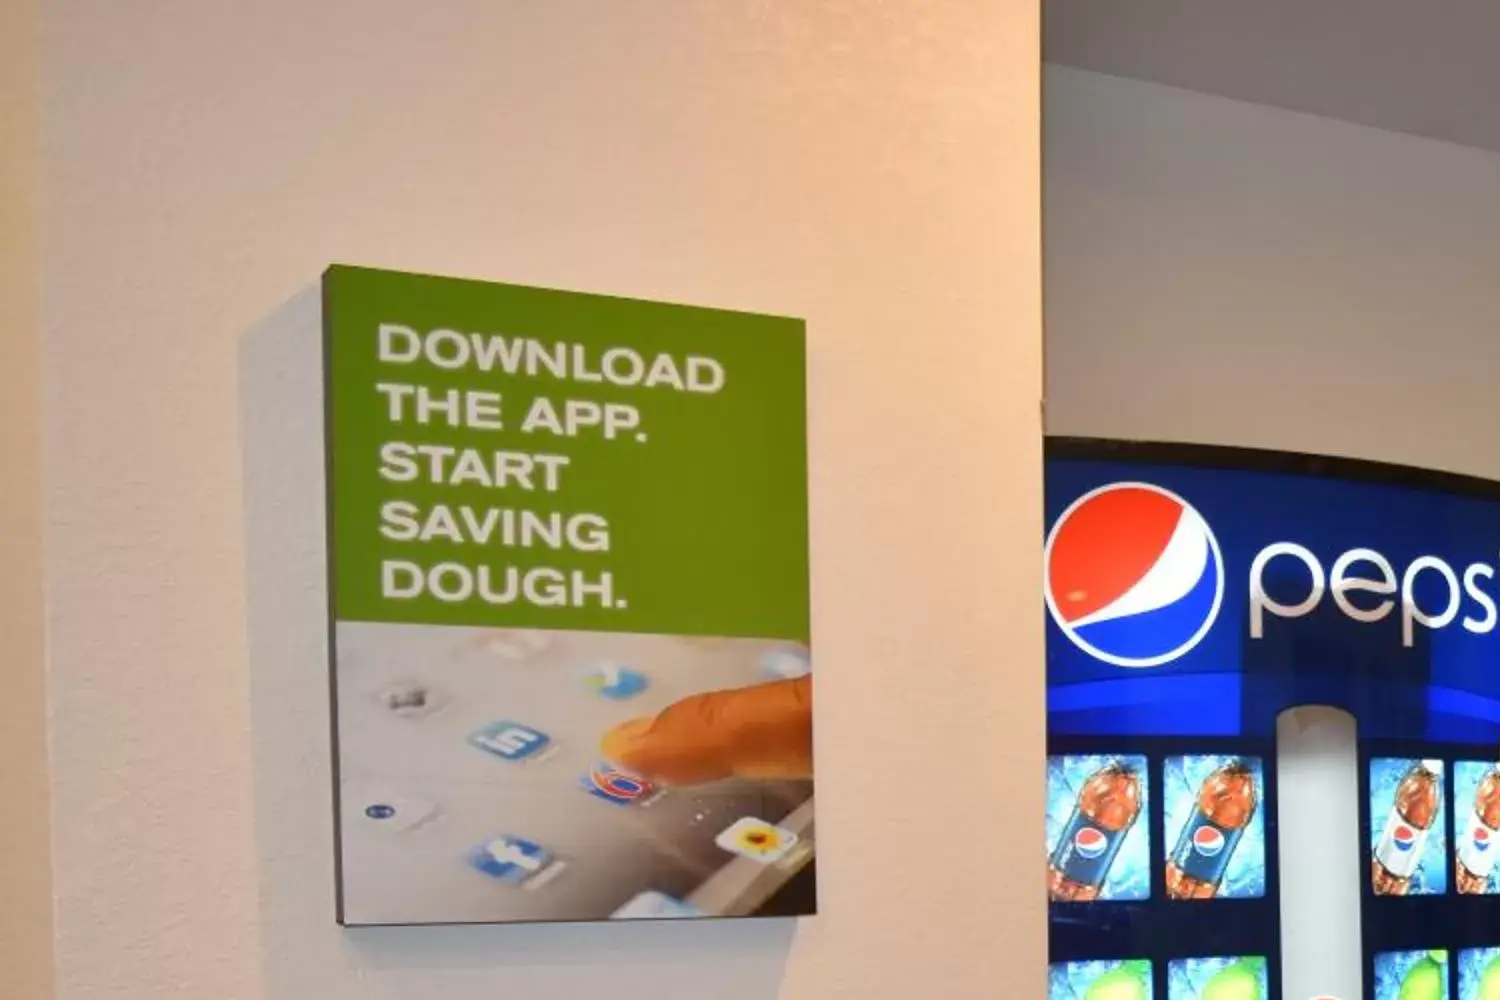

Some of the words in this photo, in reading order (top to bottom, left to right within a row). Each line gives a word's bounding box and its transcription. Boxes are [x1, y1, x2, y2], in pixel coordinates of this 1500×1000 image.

[377, 323, 726, 394] DOWNLOAD
[376, 382, 504, 431] THE
[521, 397, 648, 443] APP.
[379, 441, 570, 492] START
[379, 500, 611, 552] SAVING
[381, 559, 628, 609] DOUGH.
